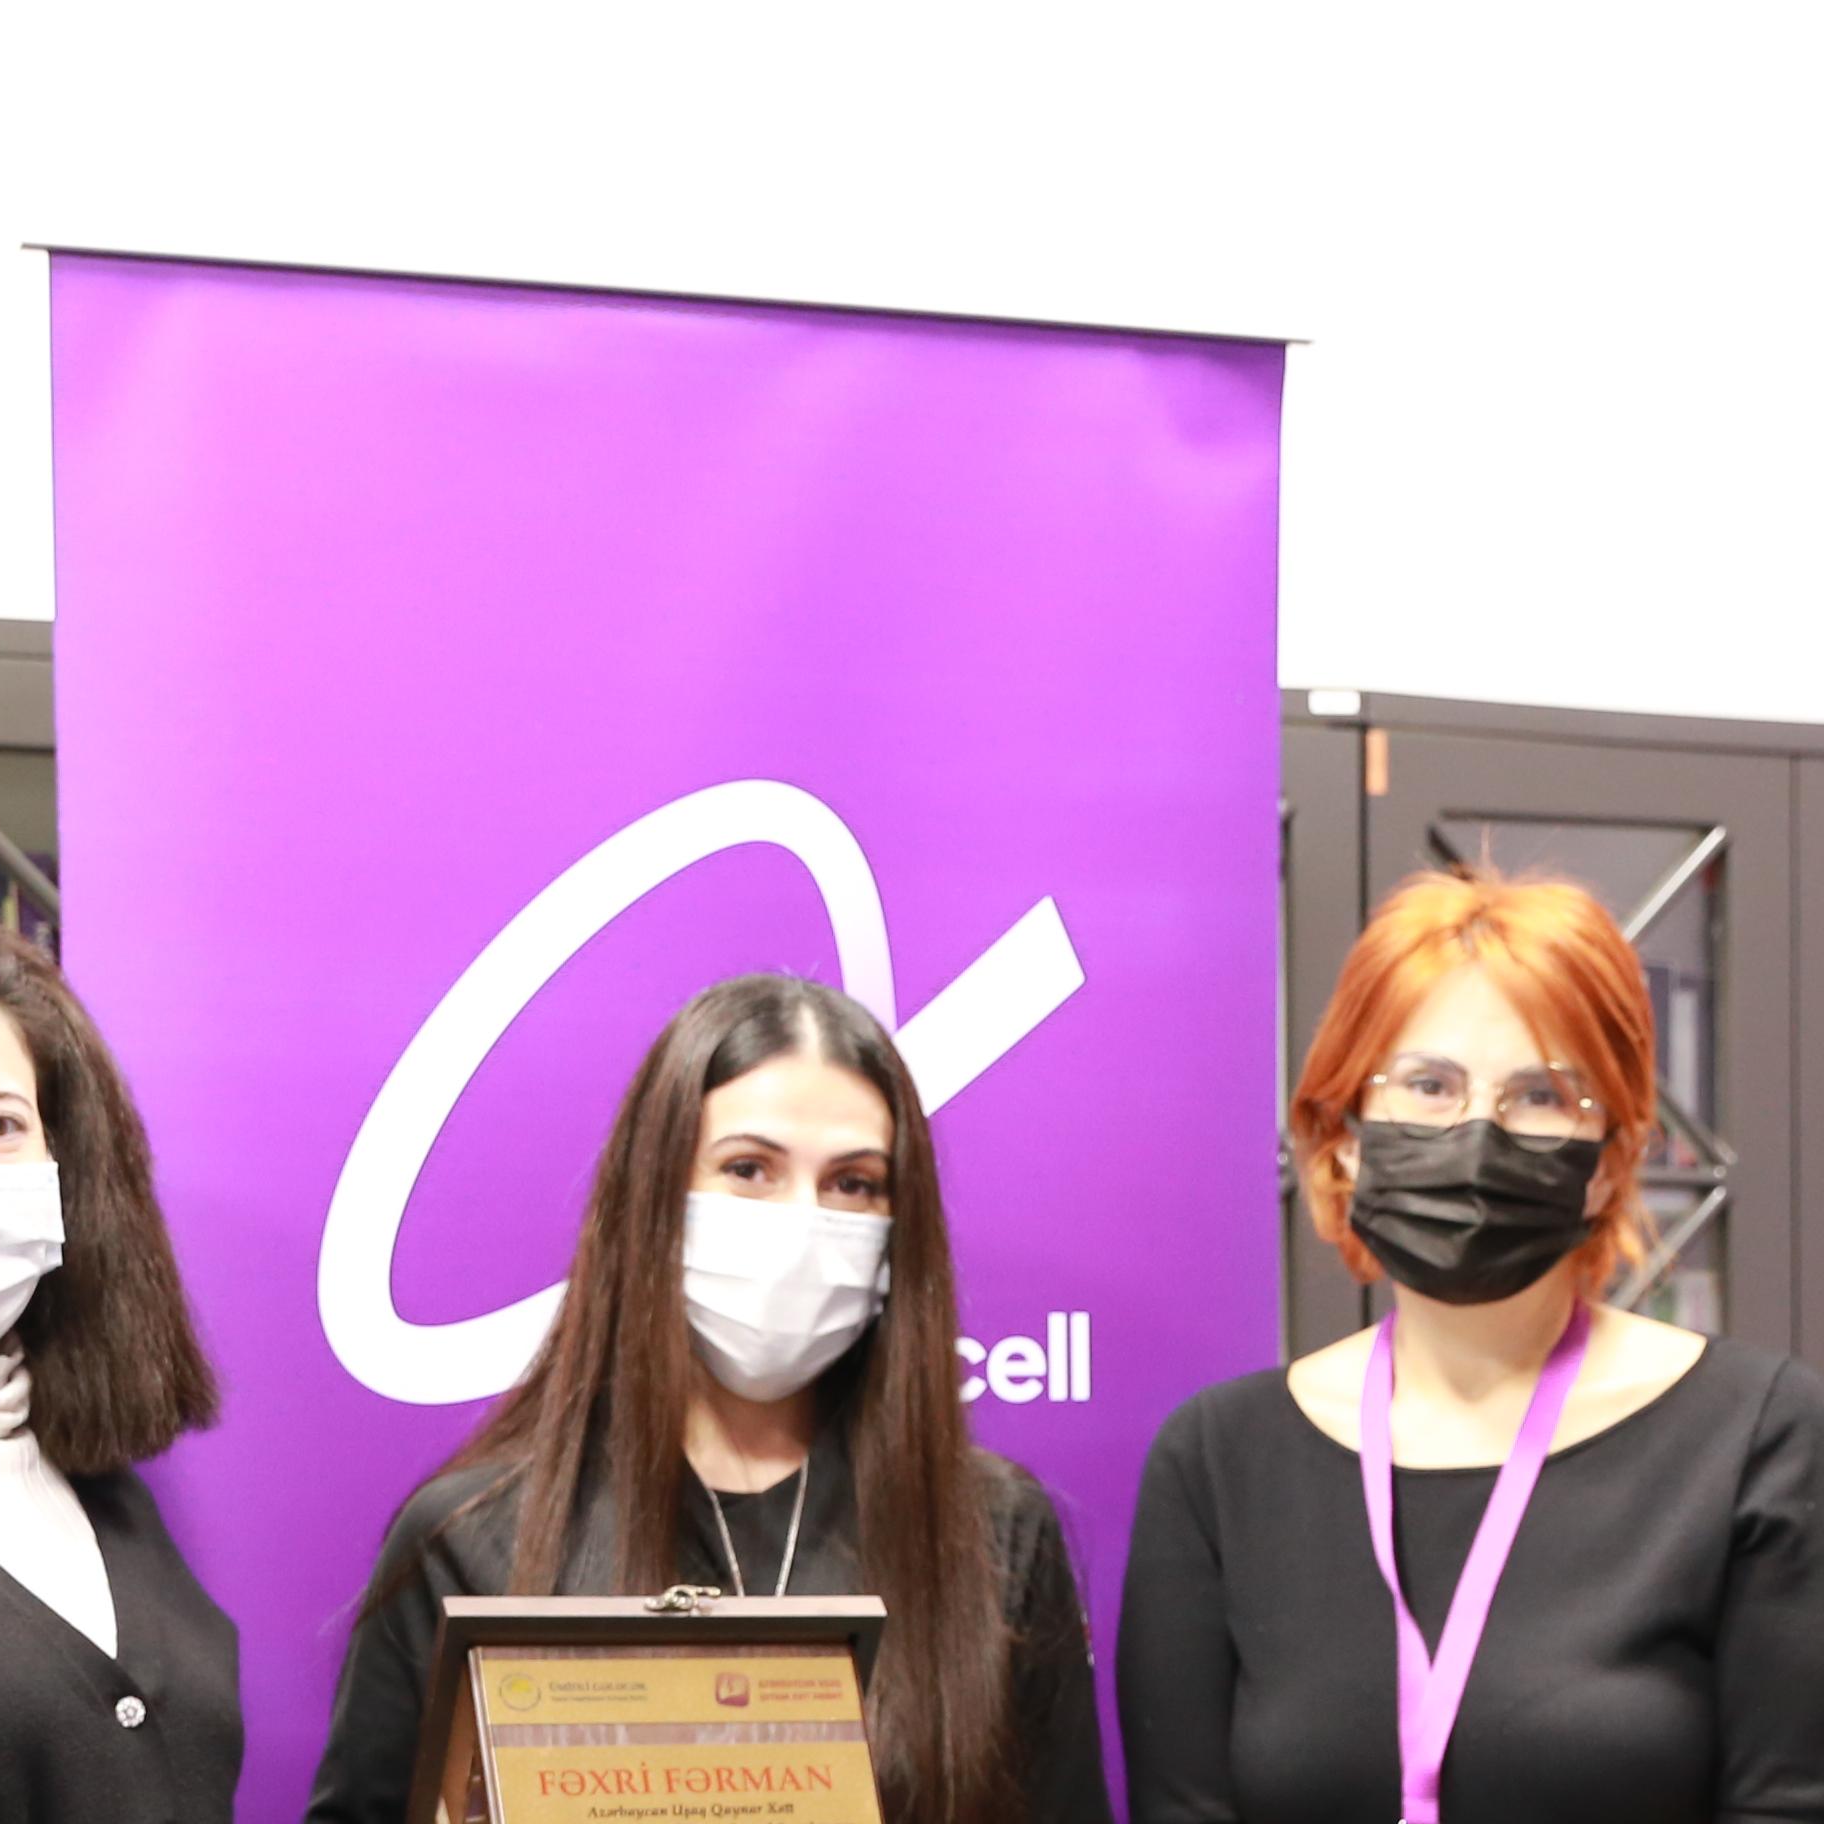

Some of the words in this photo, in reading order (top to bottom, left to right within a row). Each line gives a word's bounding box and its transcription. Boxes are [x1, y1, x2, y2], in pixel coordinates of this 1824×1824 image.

[954, 1310, 1091, 1404] cell
[538, 1761, 652, 1797] FƏXRİ
[663, 1764, 833, 1794] FƏRMAN
[588, 1806, 667, 1819] Azərbaycan
